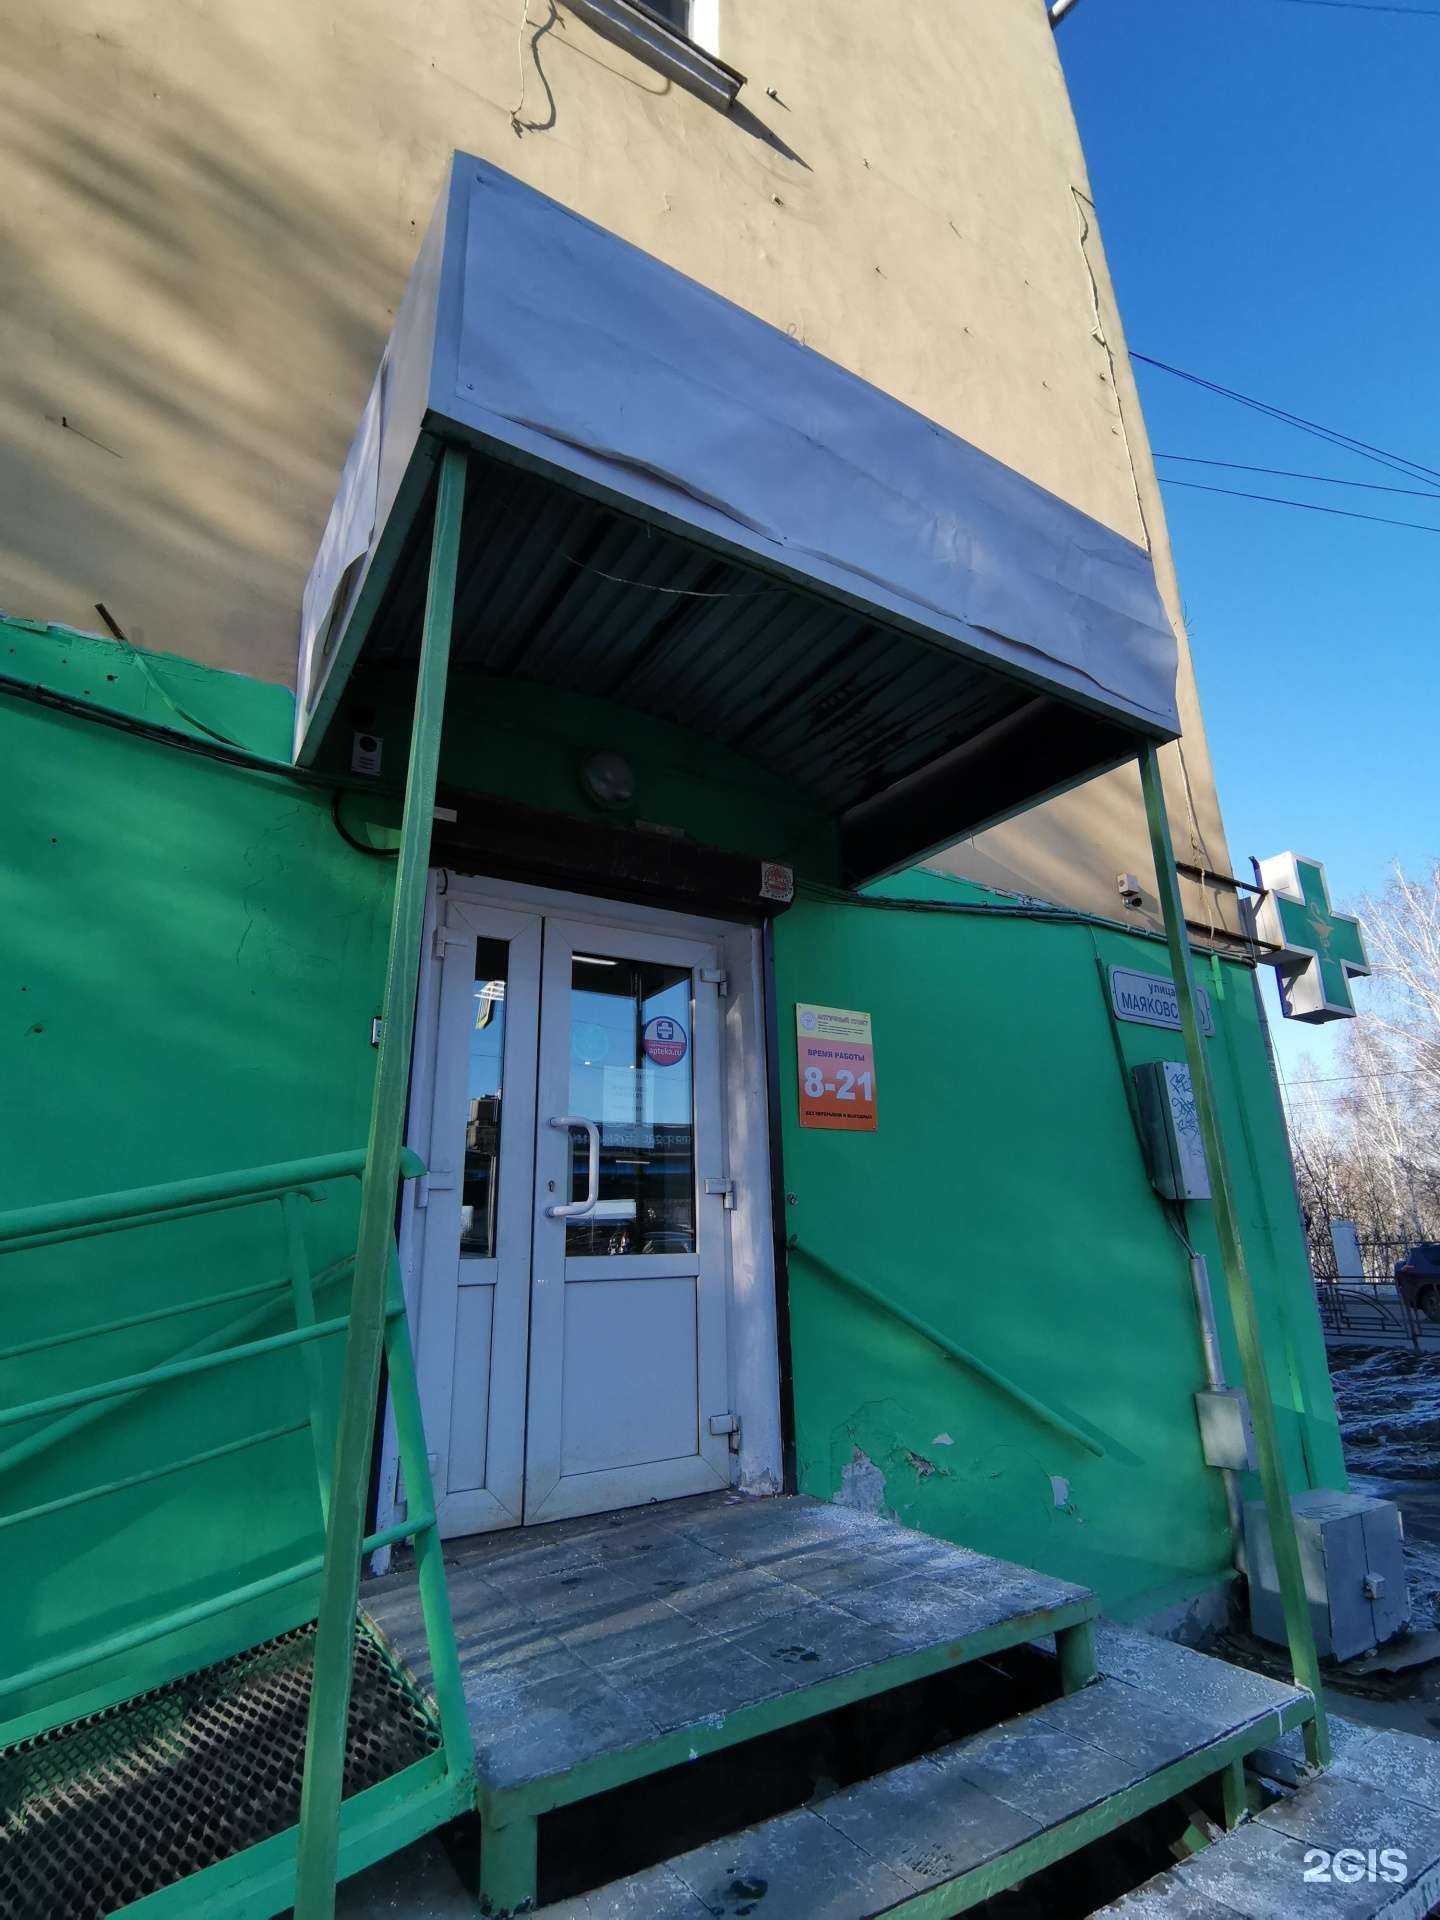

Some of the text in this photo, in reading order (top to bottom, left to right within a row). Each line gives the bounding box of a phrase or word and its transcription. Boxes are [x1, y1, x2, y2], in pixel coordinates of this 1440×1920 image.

[1148, 983, 1176, 997] улица
[807, 1049, 865, 1062] ВРЕМЯ РАБОТЫ
[804, 1066, 873, 1102] 8-21
